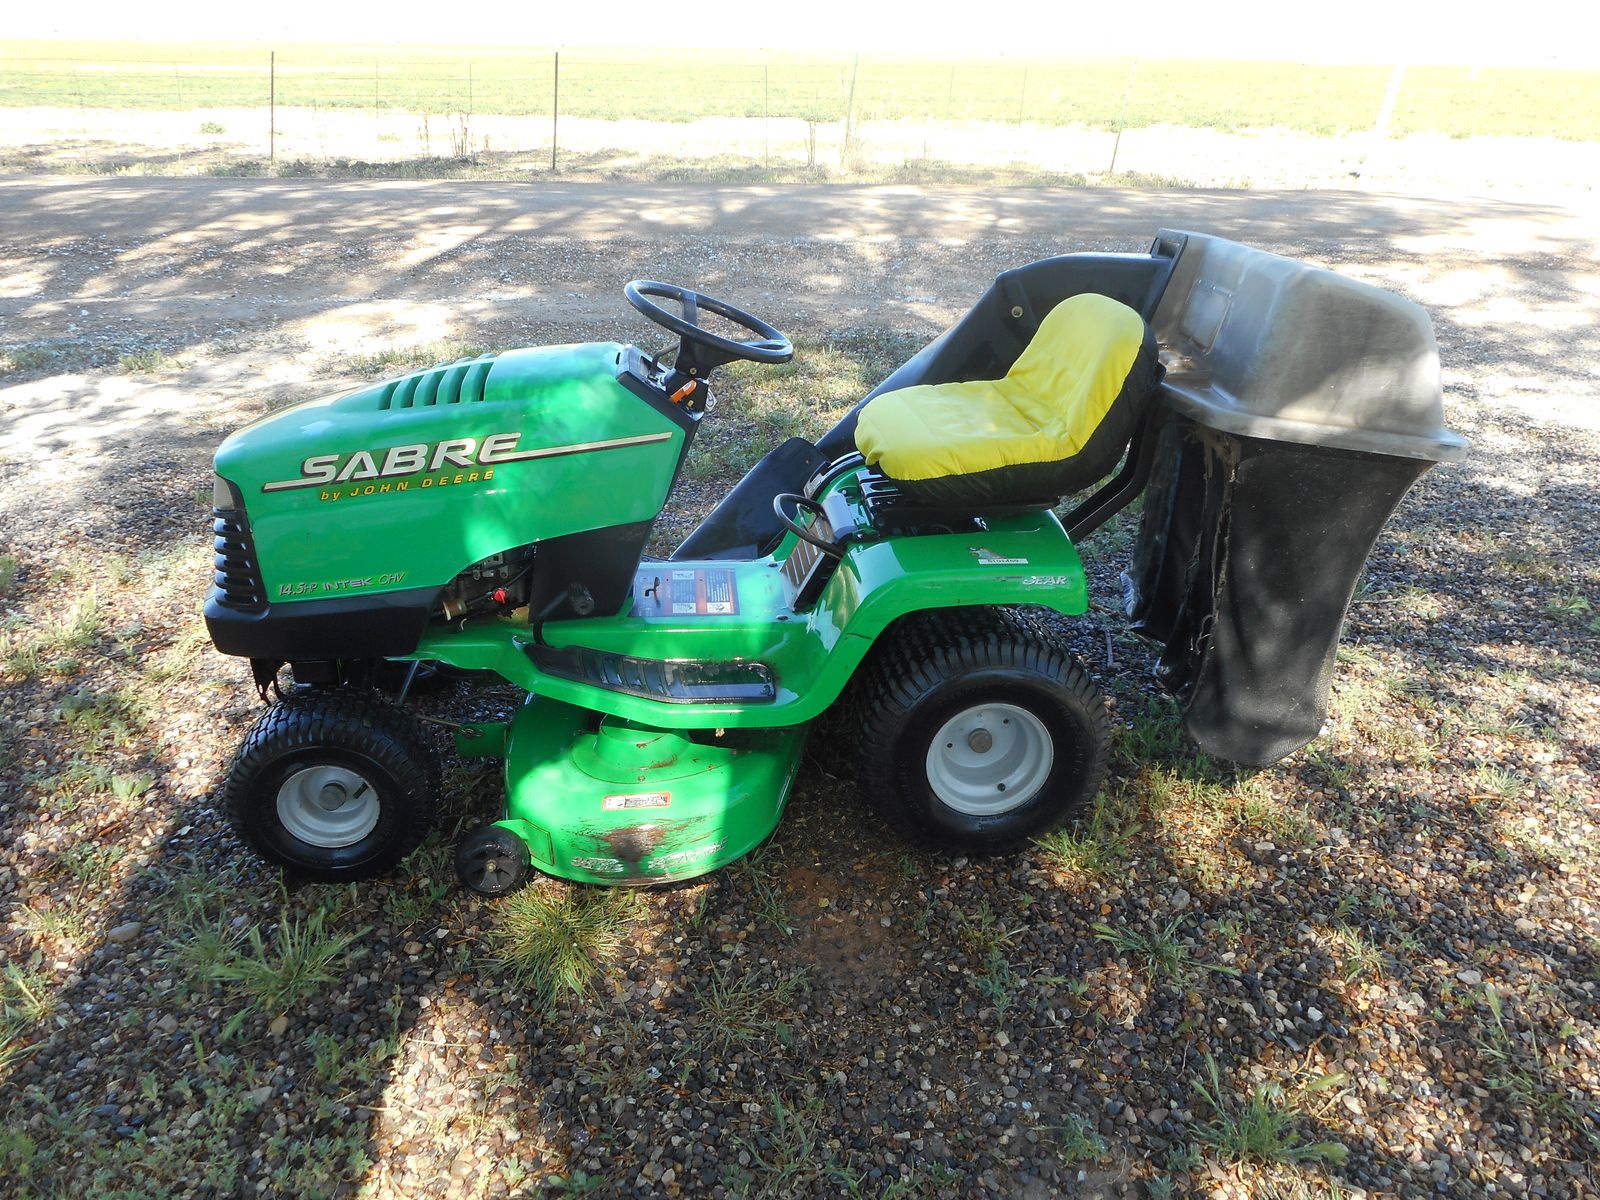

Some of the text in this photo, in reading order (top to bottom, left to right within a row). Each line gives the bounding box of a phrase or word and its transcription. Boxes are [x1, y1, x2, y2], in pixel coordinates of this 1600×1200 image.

[301, 432, 521, 487] SABRE
[320, 470, 494, 501] by JOHN DEERE
[323, 577, 373, 591] INTEK
[378, 571, 406, 586] OHV
